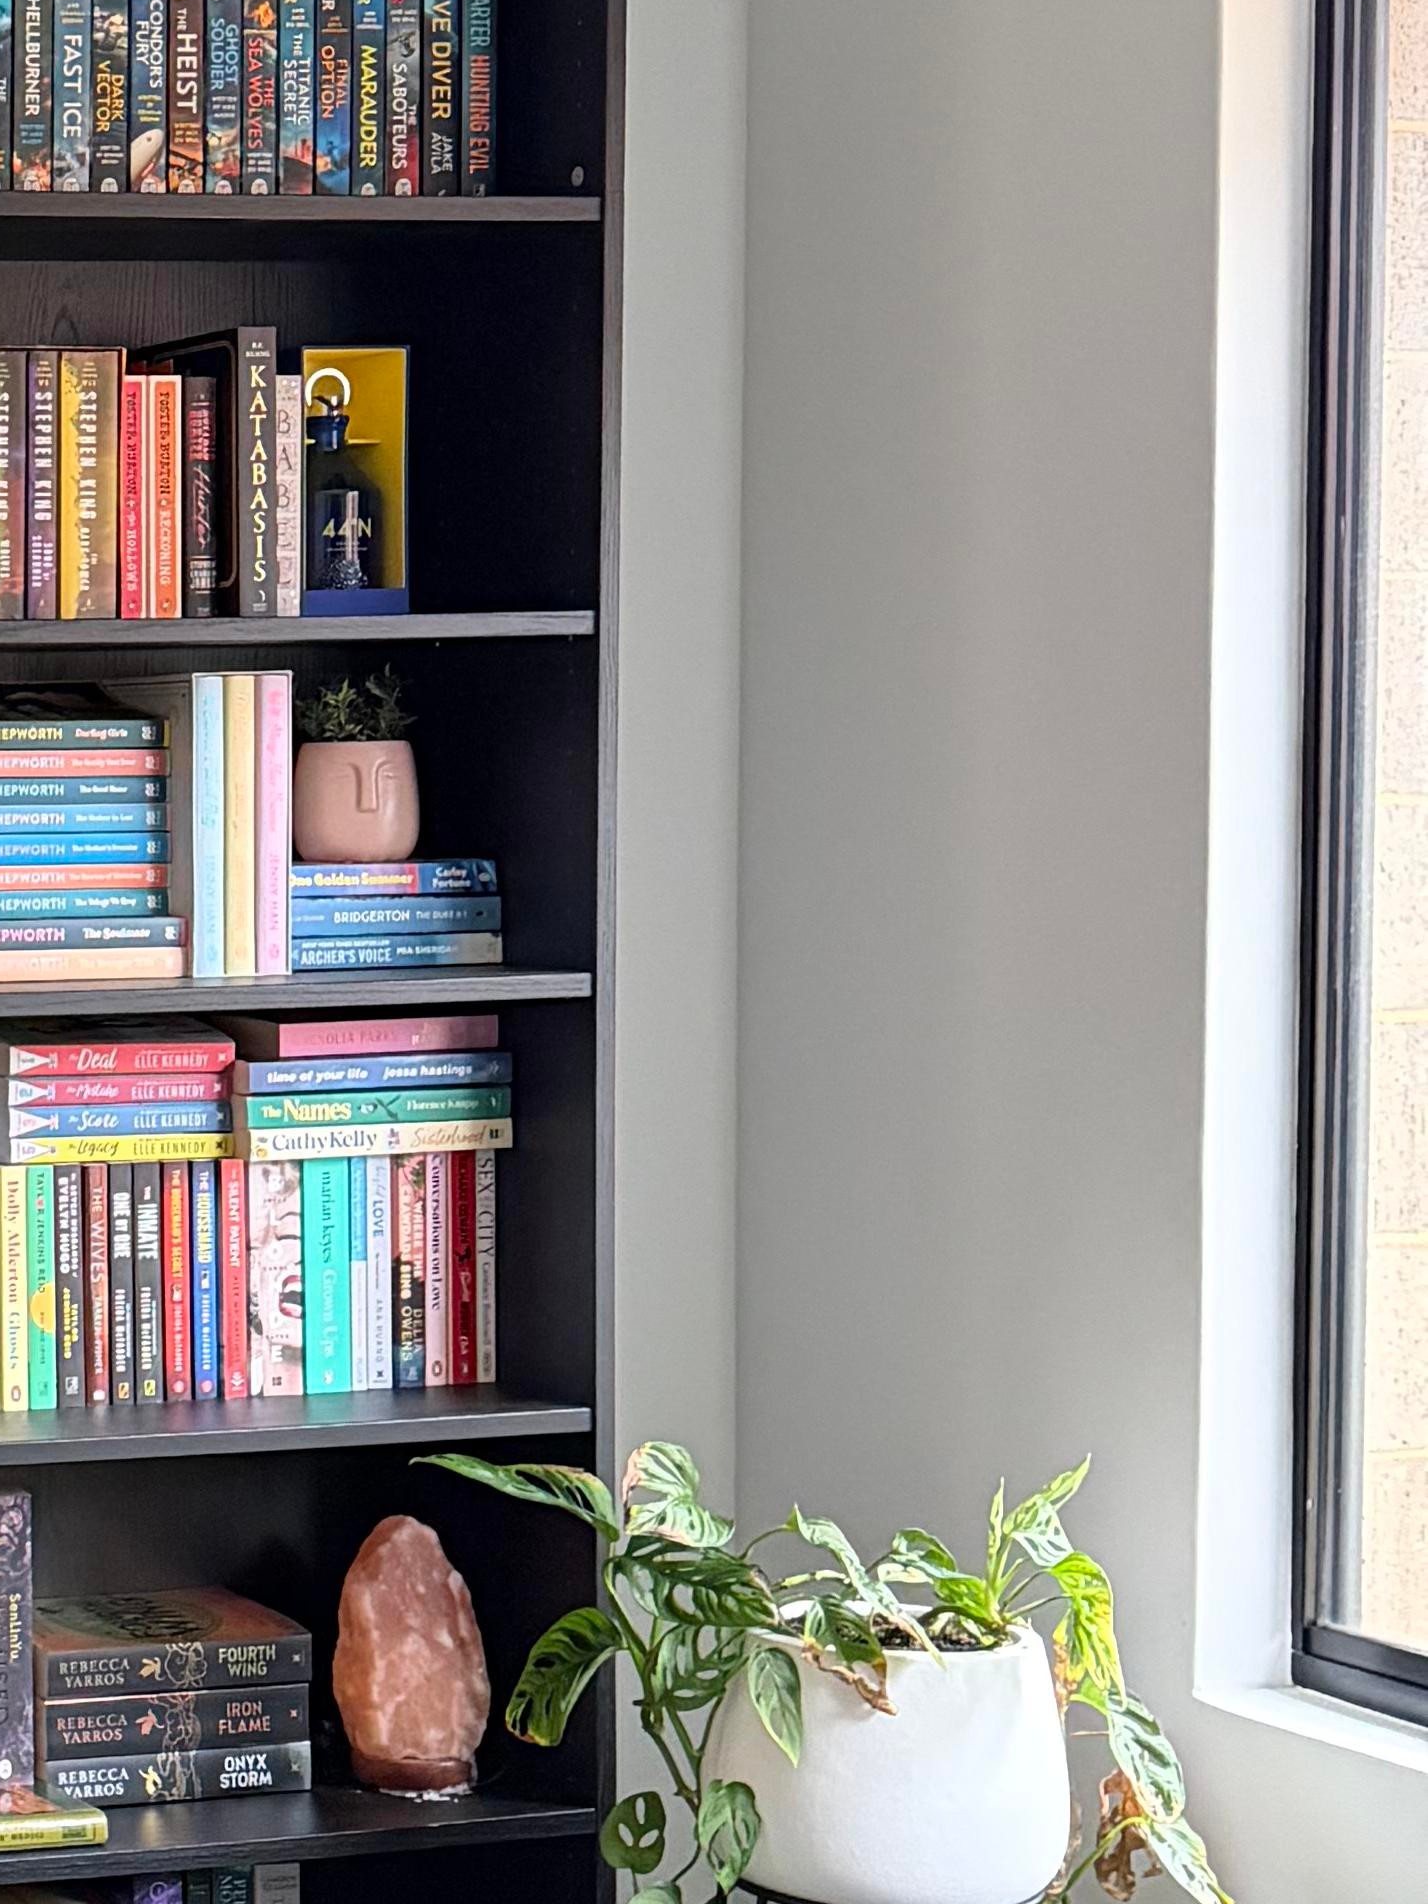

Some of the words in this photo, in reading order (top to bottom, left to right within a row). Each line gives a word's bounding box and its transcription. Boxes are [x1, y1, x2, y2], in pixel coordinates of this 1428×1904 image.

[135, 20, 149, 64] FURY
[63, 35, 82, 92] FAST
[226, 24, 238, 84] GHOST
[177, 34, 197, 112] HEIST
[432, 43, 451, 119] DIVER
[96, 61, 110, 132] VECTOR
[111, 75, 125, 120] DARK
[284, 59, 297, 125] SECRET
[297, 59, 310, 125] TITANIC
[470, 56, 490, 132] HUNTING
[360, 46, 376, 167] MARAUDER
[392, 64, 407, 169] SABOTEURS
[63, 102, 82, 137] ICE
[470, 139, 490, 174] EVIL
[250, 364, 267, 582] KATABASIS
[334, 910, 410, 923] BRIDGERTON
[359, 947, 392, 962] VOICE
[76, 1050, 116, 1070] Deal
[134, 1116, 157, 1128] ELLE
[161, 1114, 207, 1127] KENNEDY
[283, 1099, 352, 1122] Names
[219, 1646, 276, 1663] FOURTH
[60, 1658, 130, 1675] REBECCA
[228, 1662, 267, 1676] WING
[64, 1673, 125, 1688] YARROS
[227, 1702, 262, 1716] IRON
[57, 1715, 127, 1730] REBECCA
[219, 1717, 271, 1735] FLAME
[63, 1728, 123, 1744] YARROS
[225, 1754, 267, 1771] ONYX
[58, 1769, 129, 1785] REBECCA
[220, 1770, 272, 1789] STORM
